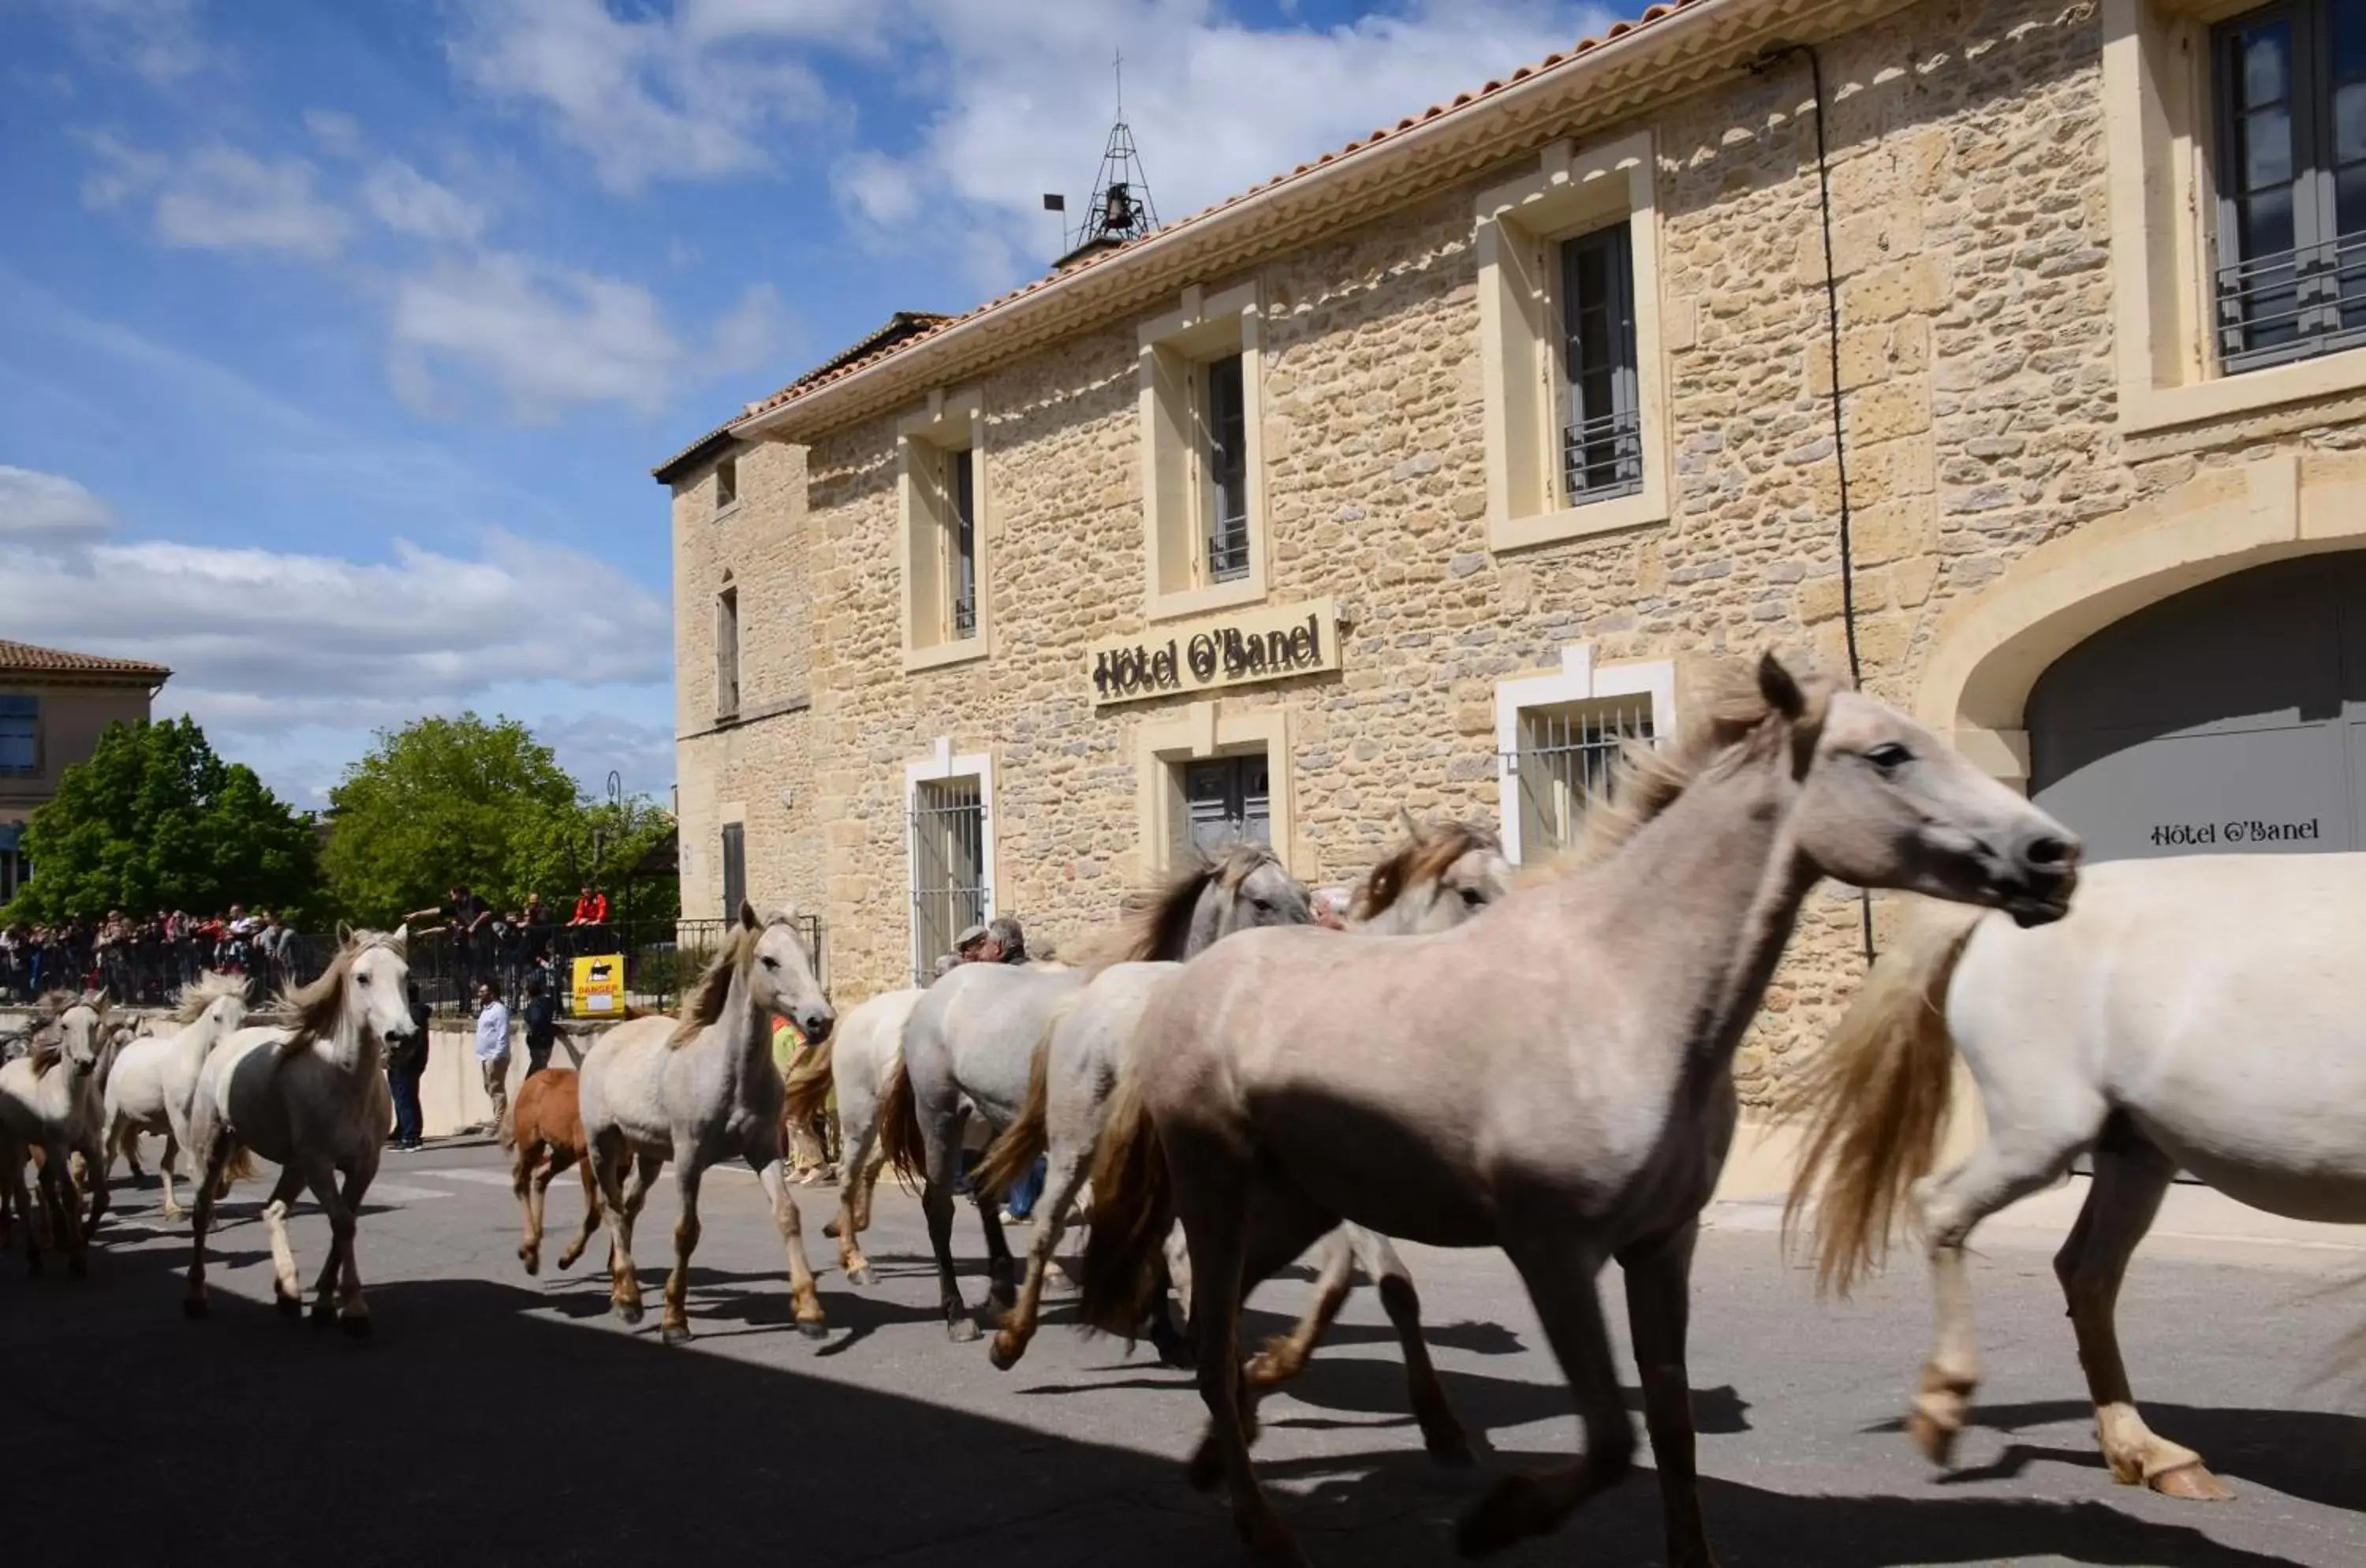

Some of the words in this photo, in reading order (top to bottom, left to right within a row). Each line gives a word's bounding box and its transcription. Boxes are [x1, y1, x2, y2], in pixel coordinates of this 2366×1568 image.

[1093, 639, 1180, 696] Hôtel
[1187, 613, 1322, 681] O'Banel
[2151, 823, 2216, 846] Hôtel
[2223, 818, 2319, 842] O'Banel
[578, 984, 619, 995] DANGER
